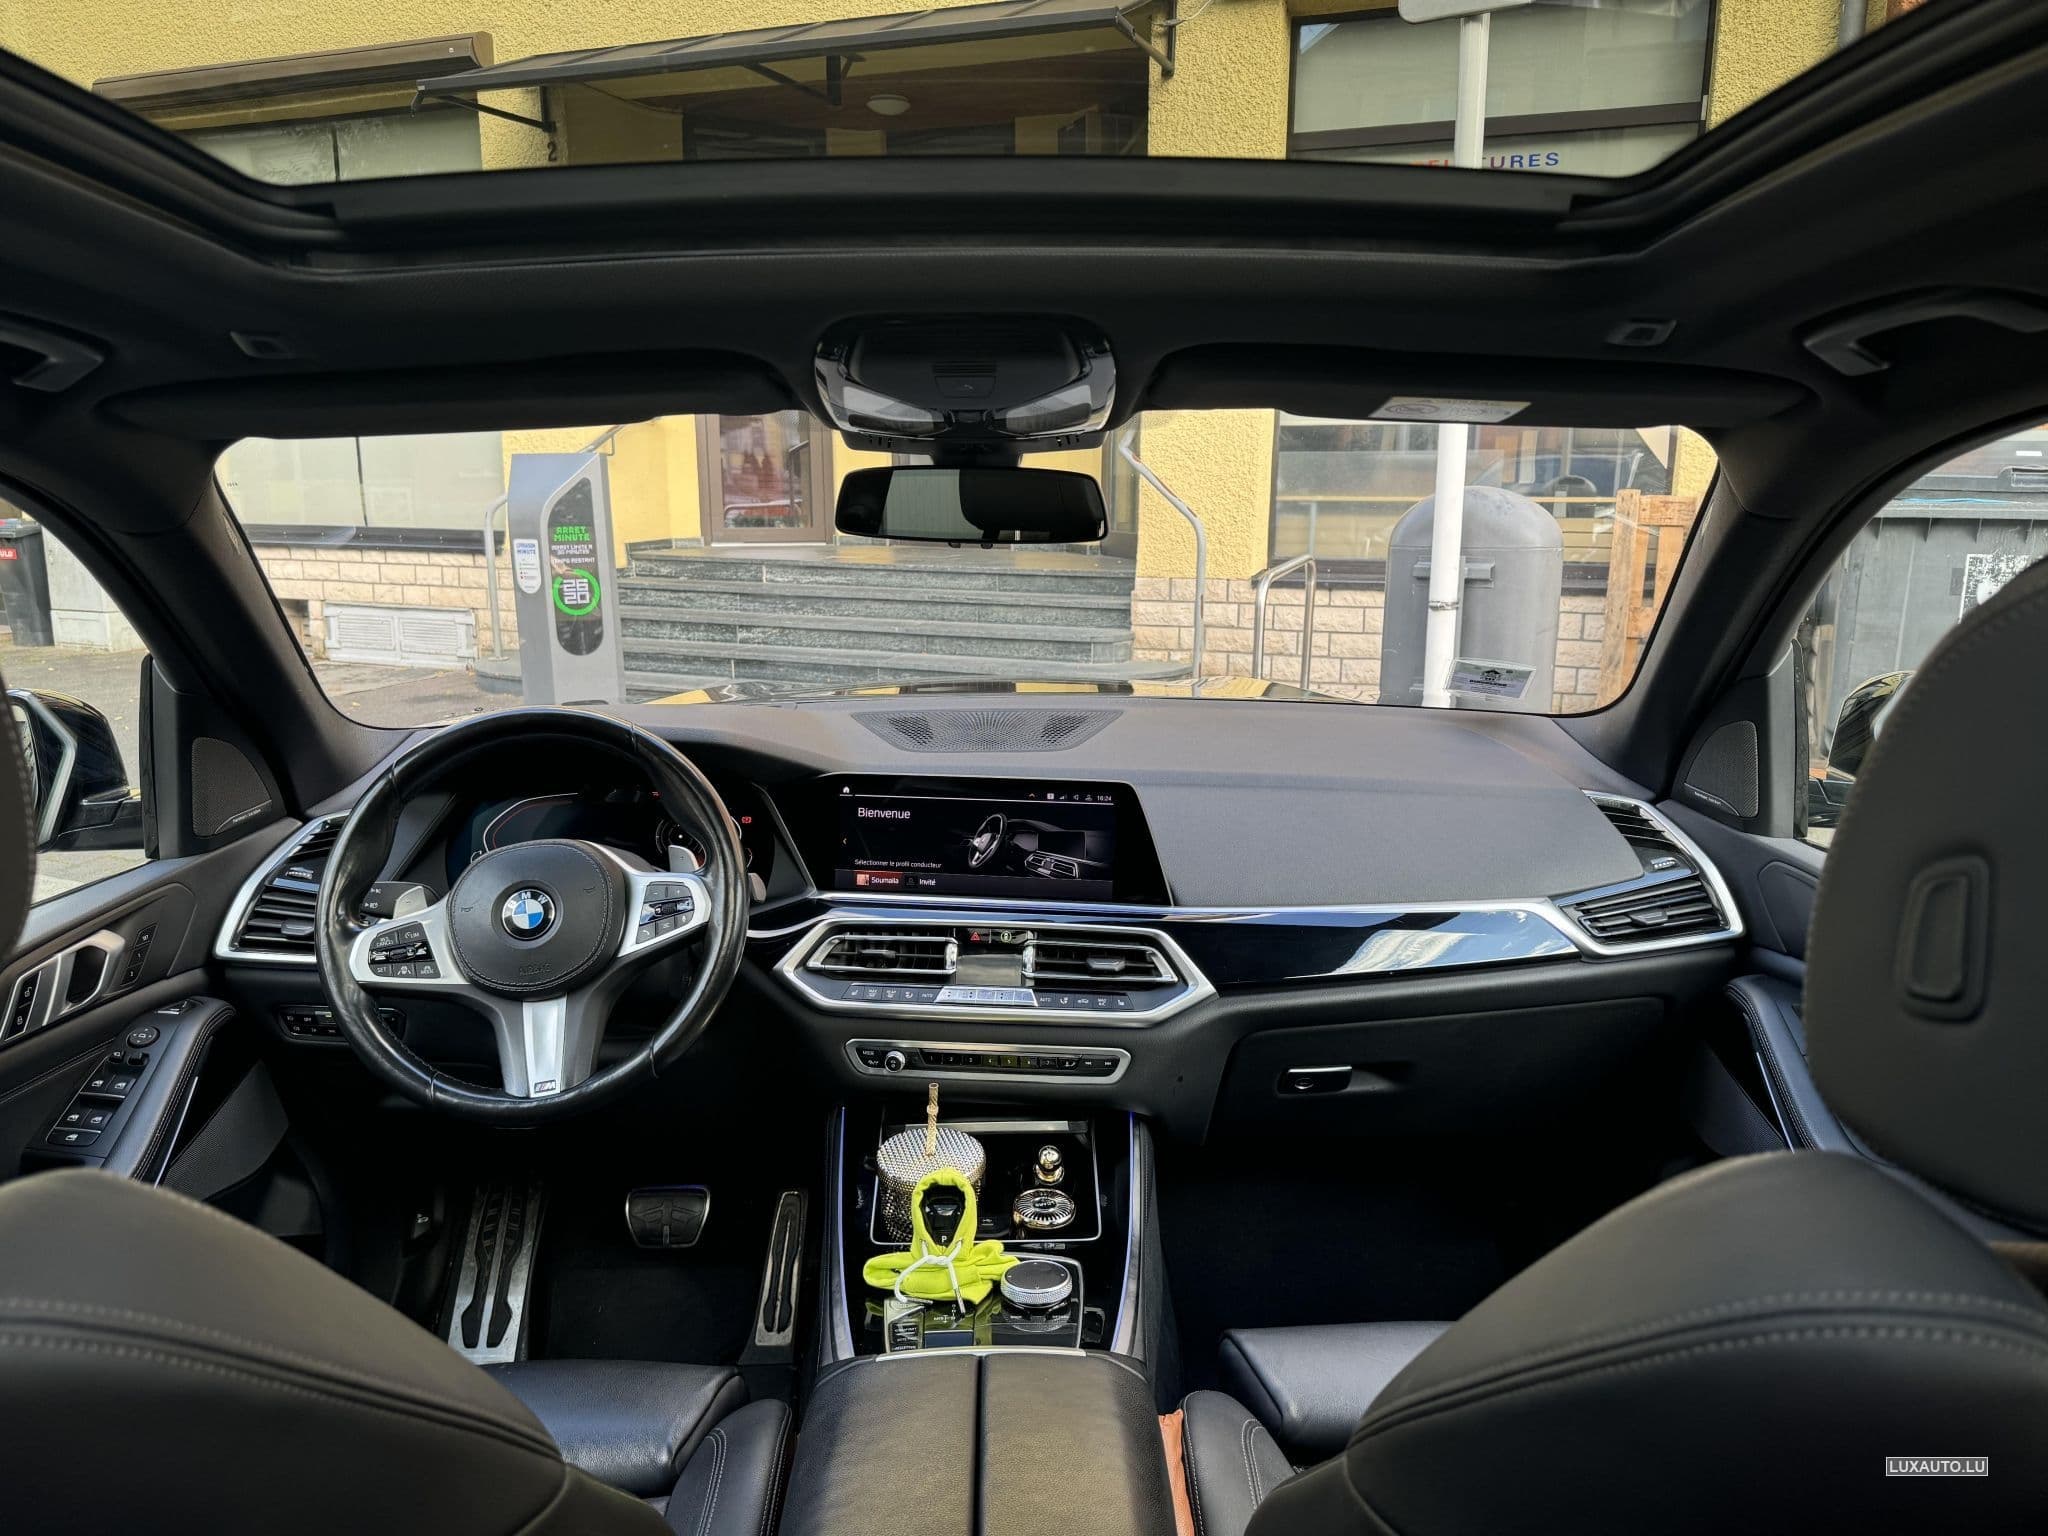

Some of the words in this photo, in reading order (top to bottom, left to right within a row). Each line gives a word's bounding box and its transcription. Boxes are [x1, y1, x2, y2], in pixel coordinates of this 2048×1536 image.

[547, 142, 557, 161] 2
[556, 526, 586, 534] ARRET
[554, 533, 591, 541] MINUTE
[857, 807, 911, 819] Bienvenue
[508, 892, 548, 909] BMW
